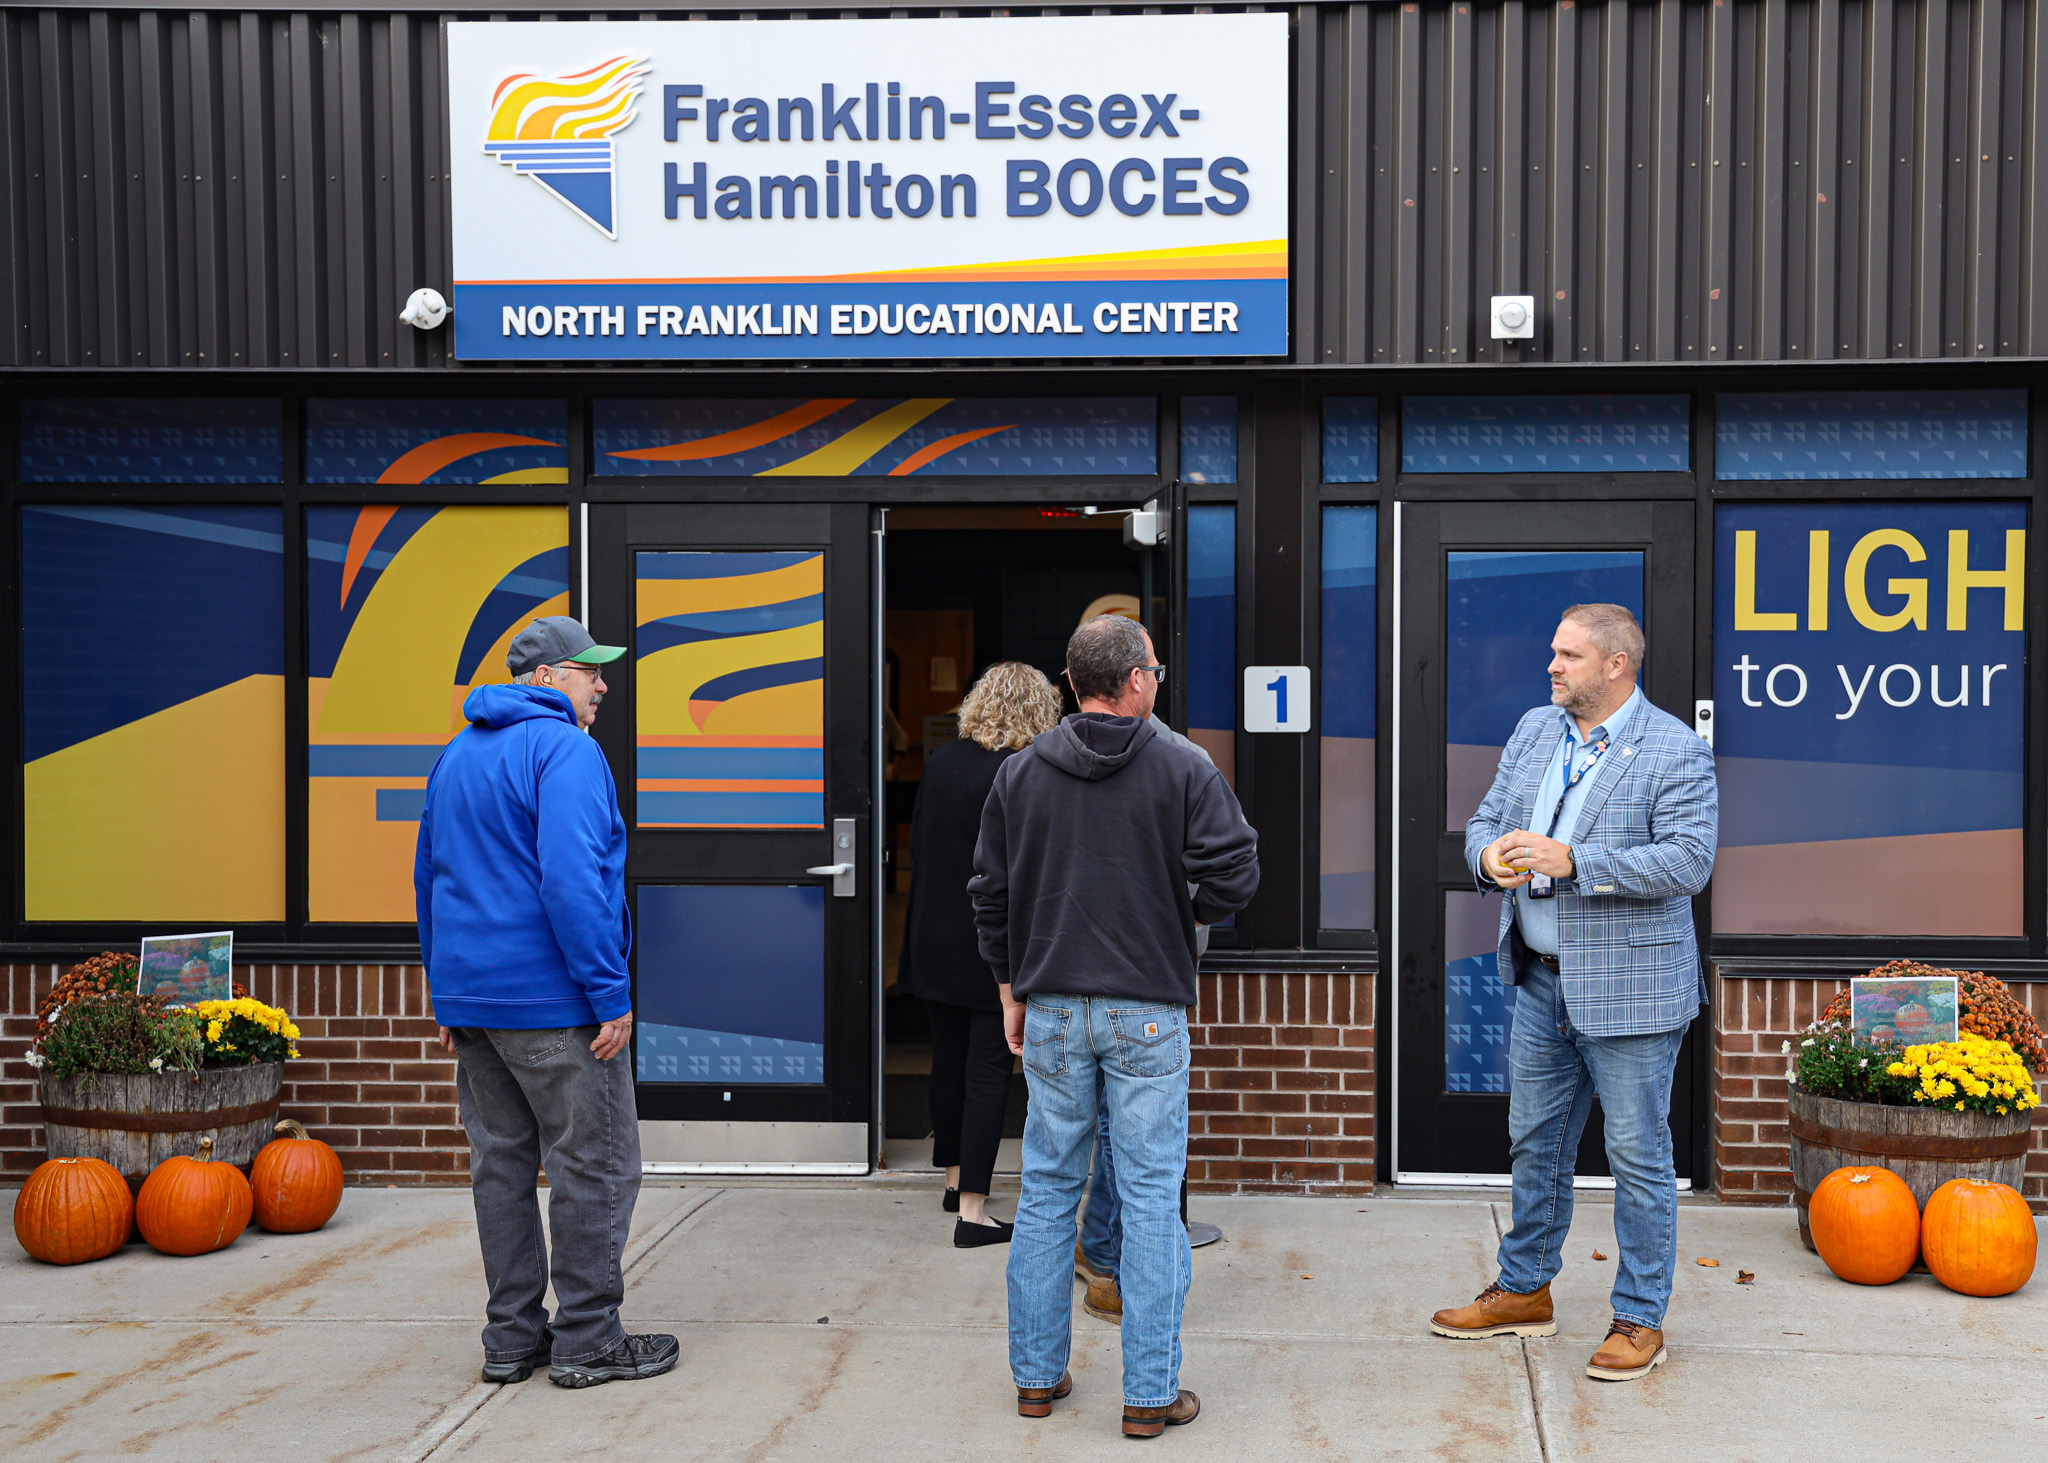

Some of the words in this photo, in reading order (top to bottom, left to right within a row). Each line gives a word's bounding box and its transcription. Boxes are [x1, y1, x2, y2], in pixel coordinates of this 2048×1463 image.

[664, 82, 1201, 144] Franklin-Essex-
[664, 160, 978, 222] Hamilton
[1007, 157, 1251, 219] BOCES
[503, 306, 626, 337] NORTH
[638, 304, 819, 337] FRANKLIN
[831, 303, 1085, 336] EDUCATIONAL
[1093, 302, 1240, 334] CENTER
[1735, 529, 2027, 634] LIGH
[1267, 675, 1288, 723] 1
[1733, 655, 1809, 708] to
[1836, 664, 2008, 721] your
